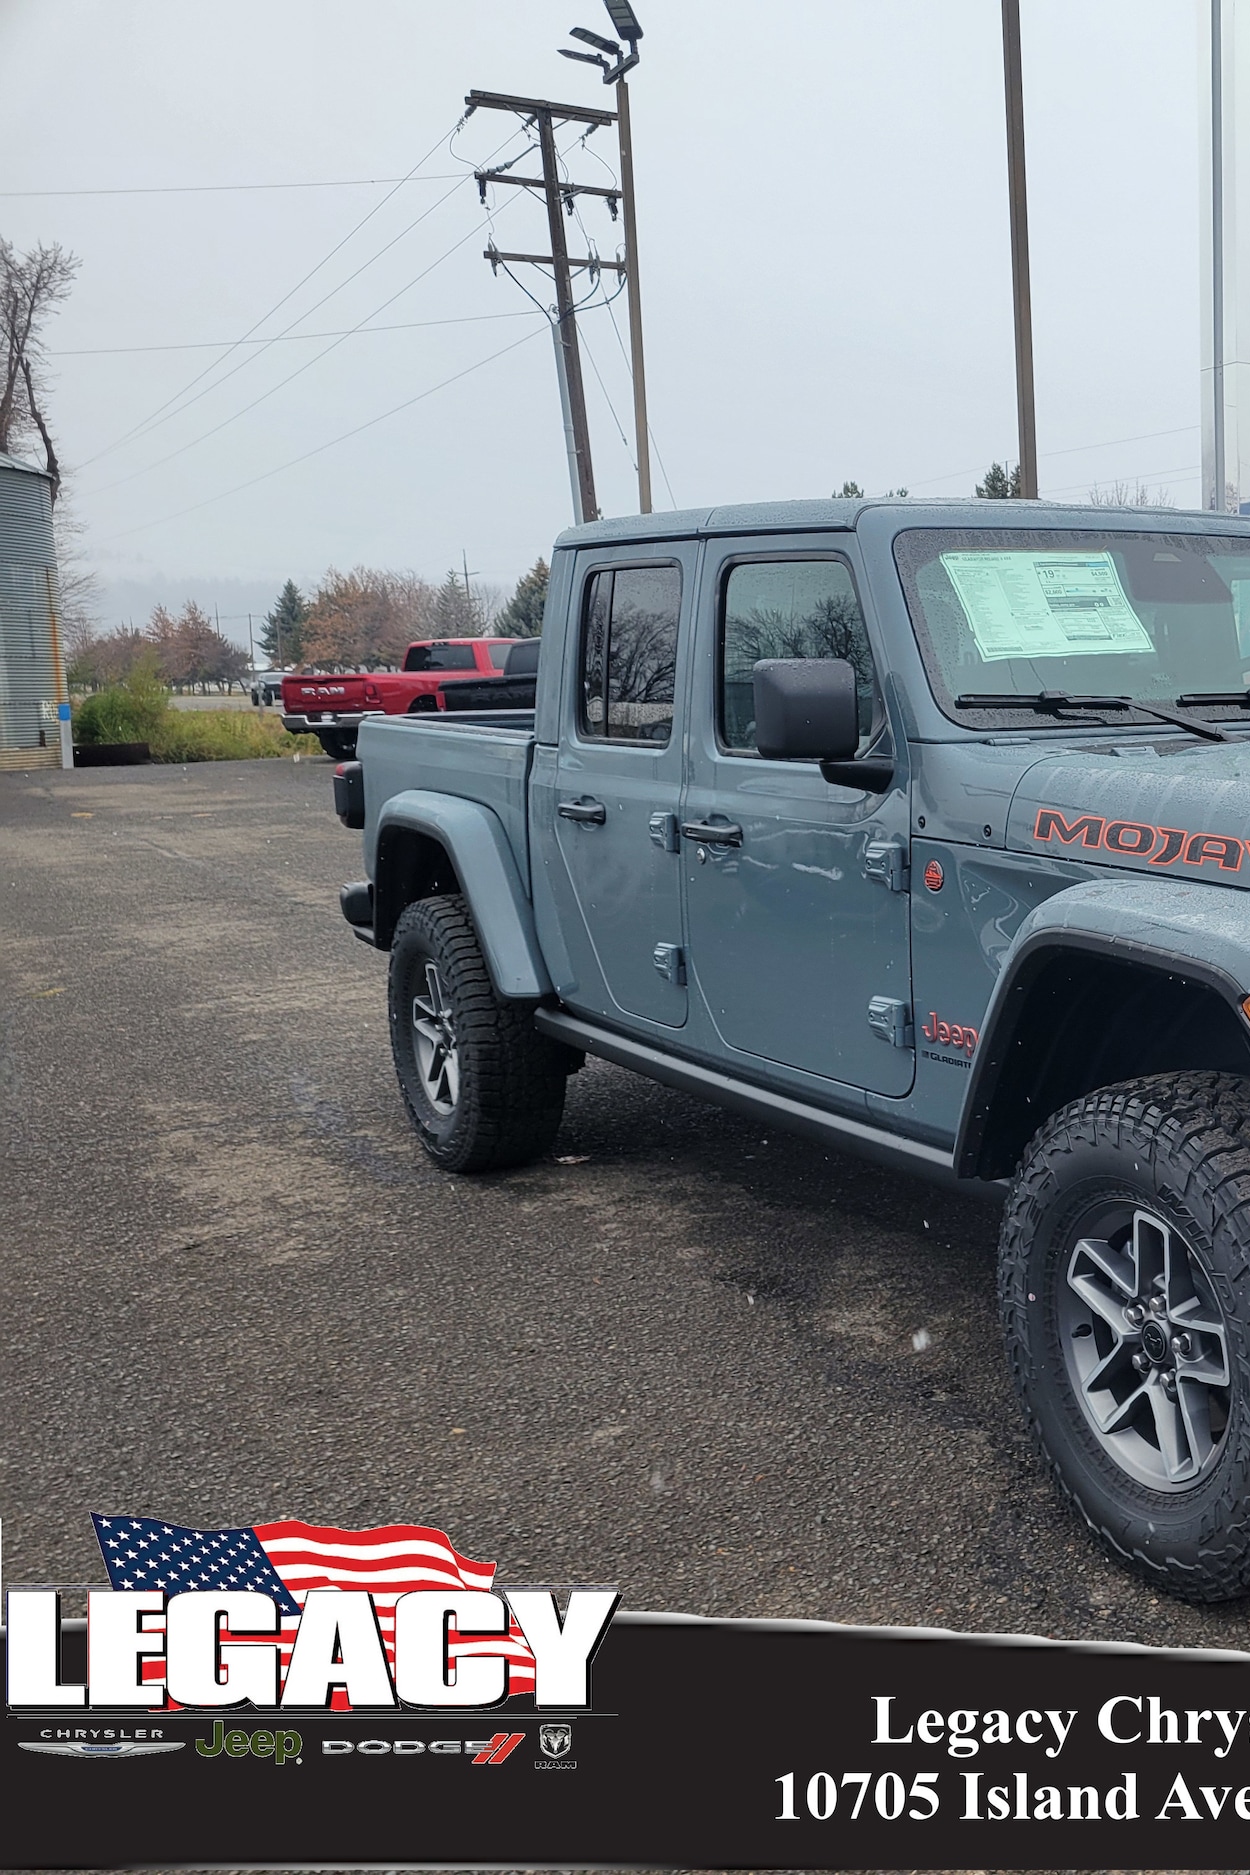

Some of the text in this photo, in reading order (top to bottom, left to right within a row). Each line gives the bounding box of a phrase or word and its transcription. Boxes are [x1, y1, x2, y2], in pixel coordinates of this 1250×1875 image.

[1042, 569, 1055, 579] 19
[300, 687, 345, 696] RAM
[921, 1011, 979, 1058] Jeep
